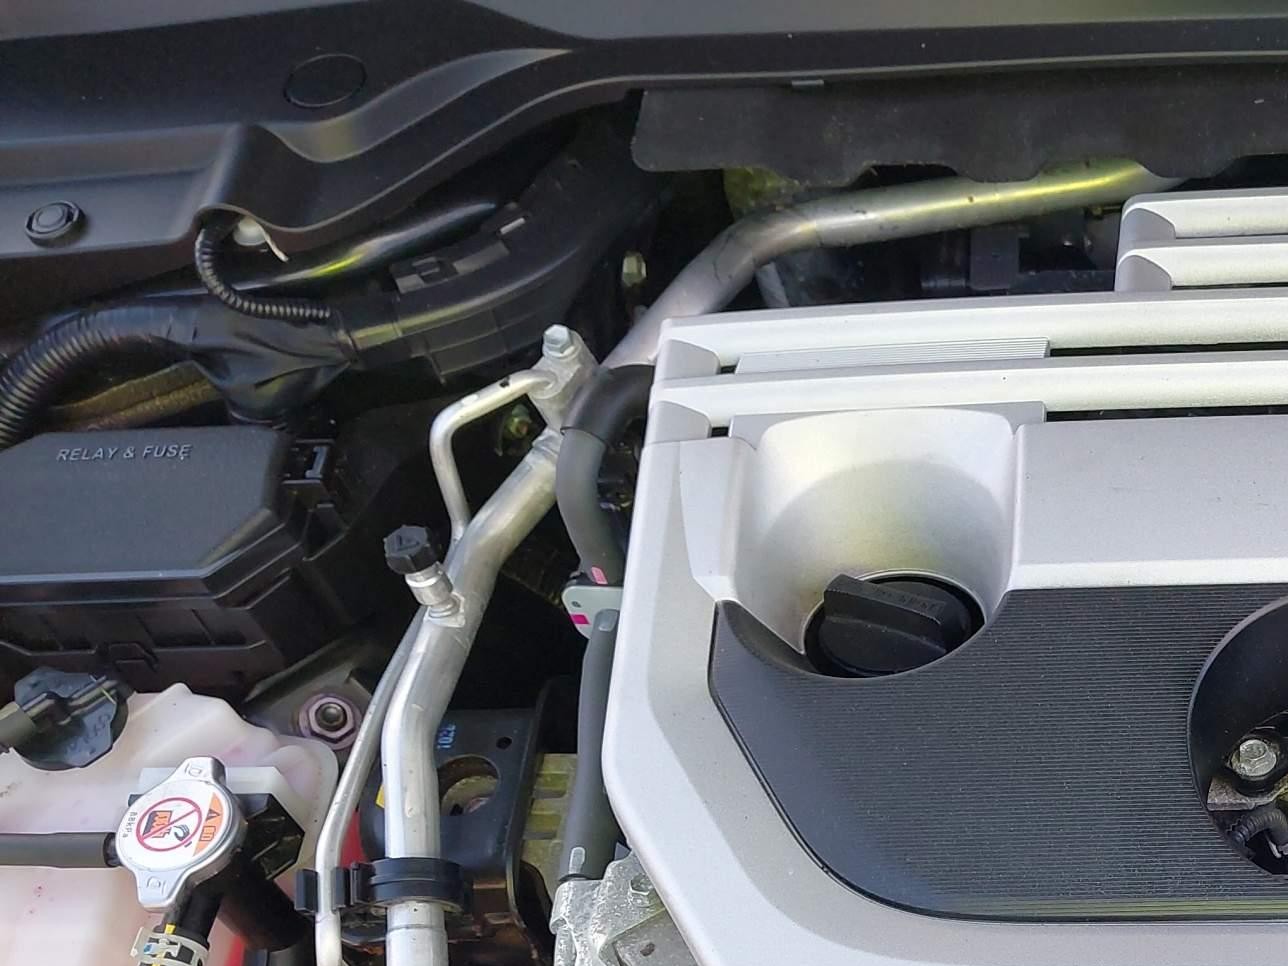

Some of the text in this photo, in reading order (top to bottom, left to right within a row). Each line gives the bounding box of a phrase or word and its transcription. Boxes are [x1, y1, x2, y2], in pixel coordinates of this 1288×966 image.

[56, 444, 193, 461] RELAY & FUSE
